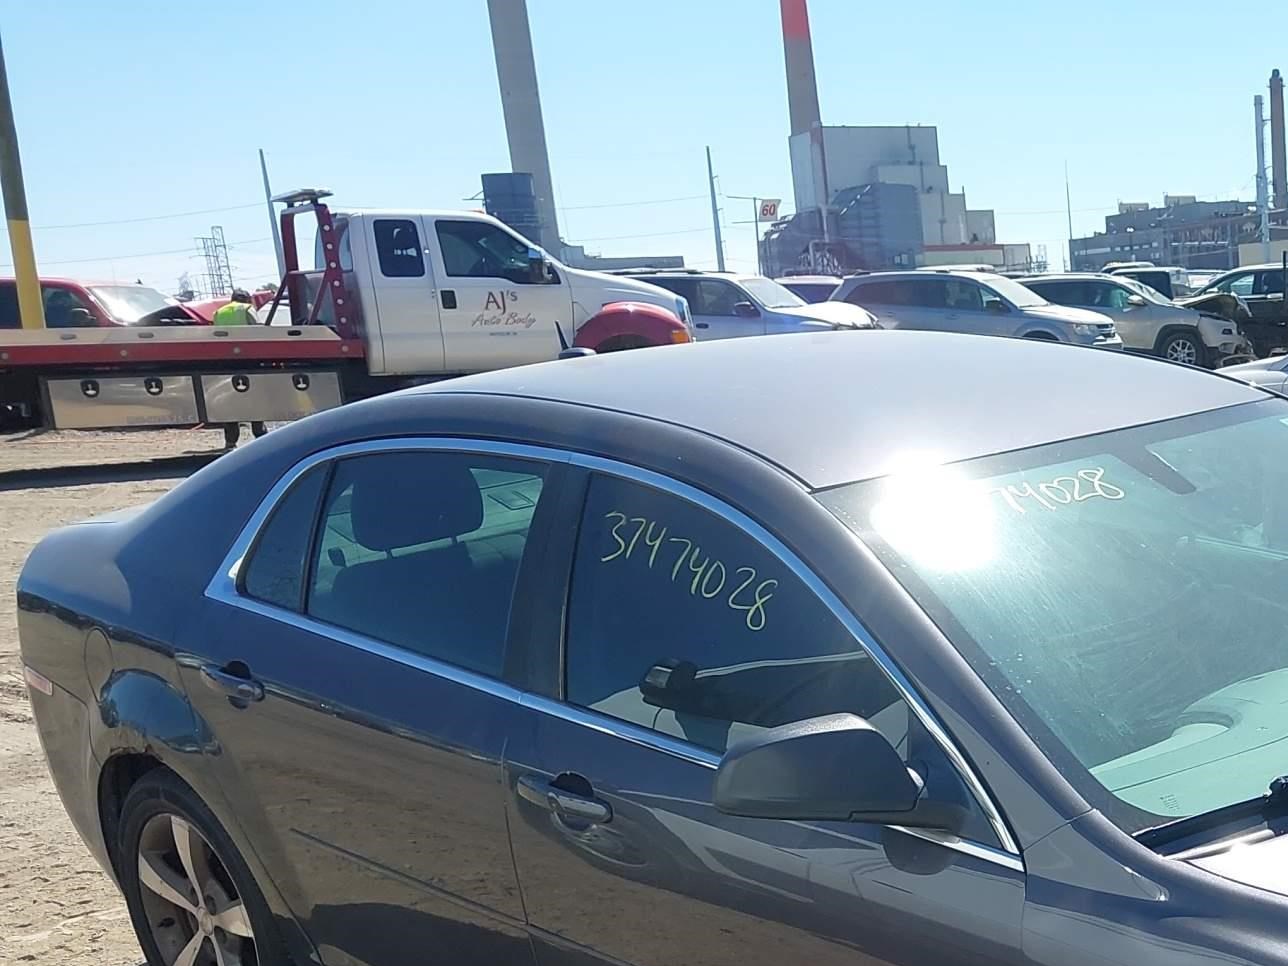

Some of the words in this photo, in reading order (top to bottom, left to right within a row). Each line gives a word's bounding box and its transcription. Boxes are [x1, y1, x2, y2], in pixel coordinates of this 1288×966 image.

[762, 203, 776, 216] 60
[485, 290, 518, 315] AJ's
[505, 311, 537, 329] Body
[600, 511, 778, 631] 37474028
